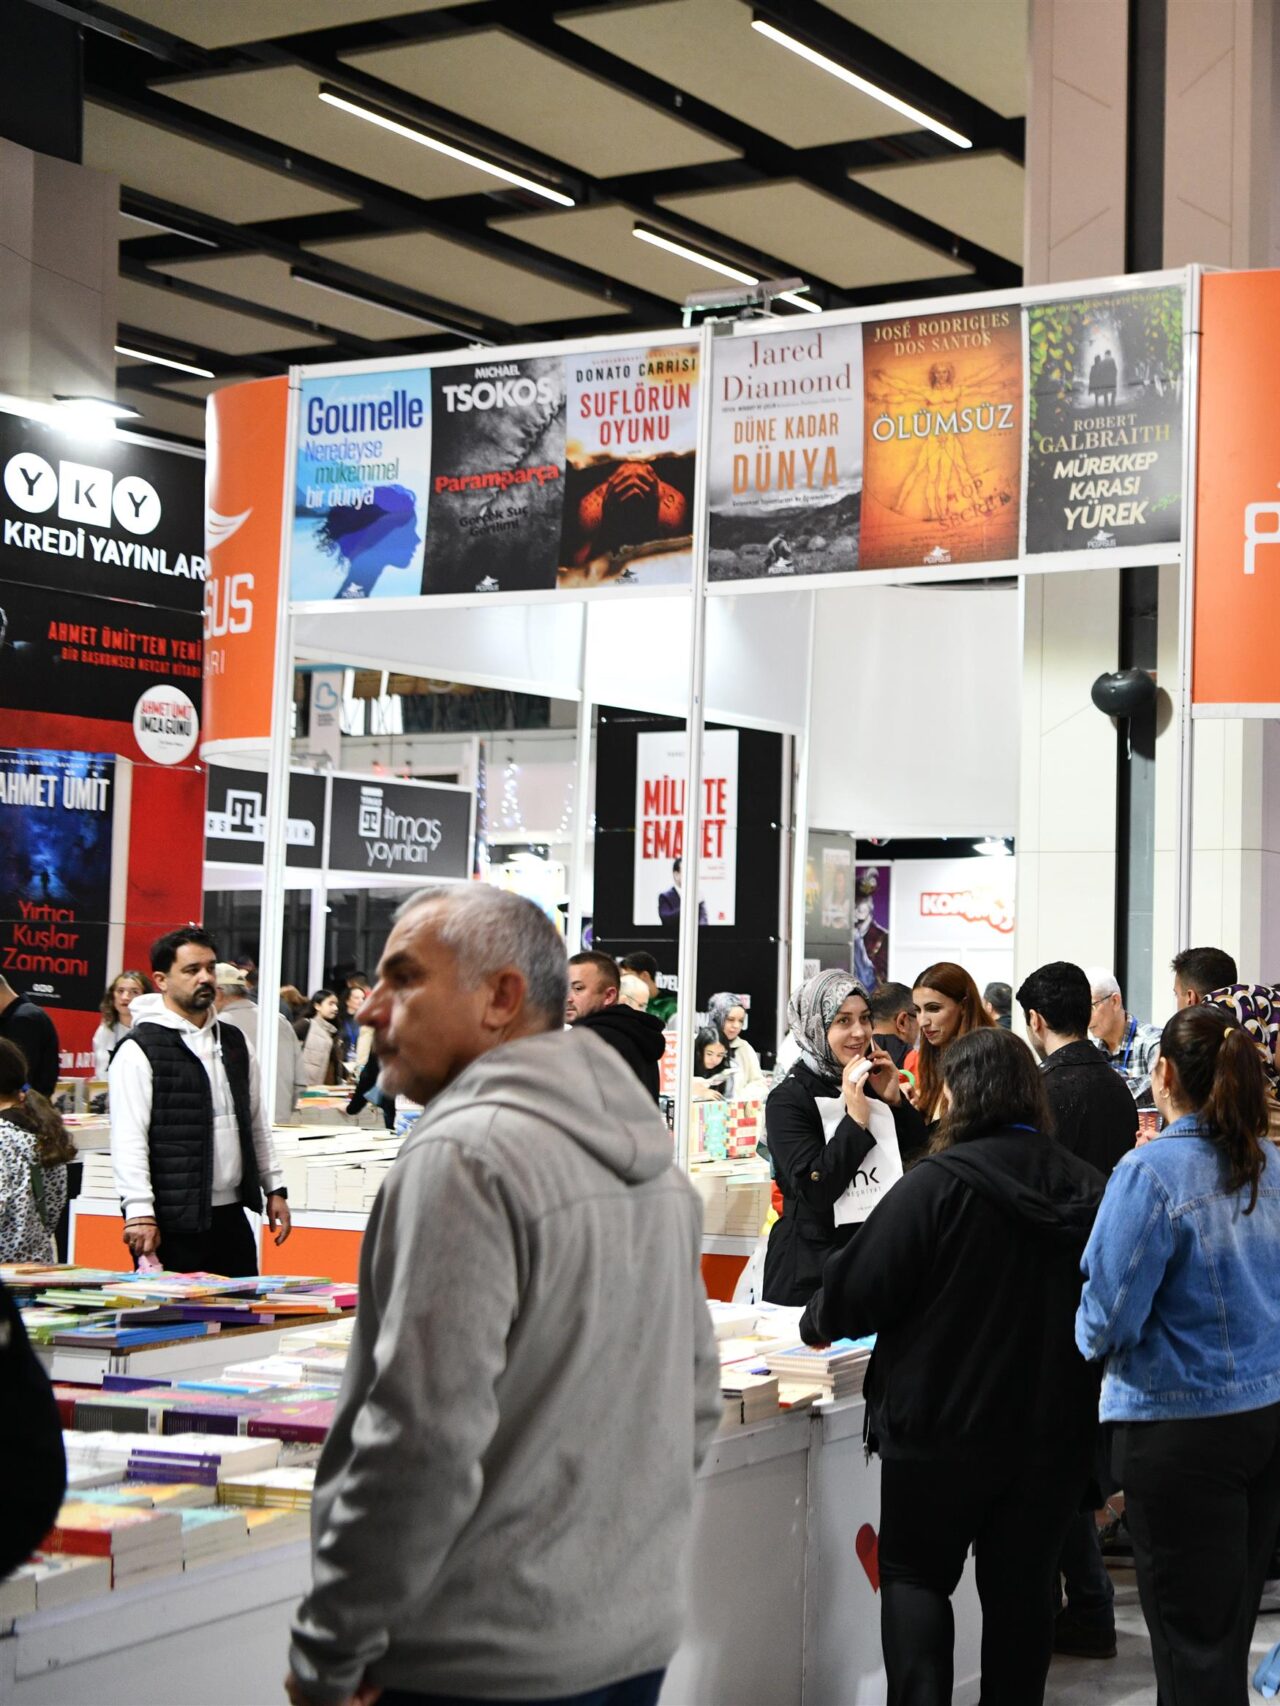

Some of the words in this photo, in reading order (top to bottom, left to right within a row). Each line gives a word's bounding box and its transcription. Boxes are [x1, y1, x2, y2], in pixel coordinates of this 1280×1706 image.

[874, 320, 911, 342] JOSÉ
[918, 311, 1010, 335] RODRIGUES
[749, 332, 823, 369] Jared
[894, 339, 925, 356] DOS
[931, 330, 992, 351] SANTOS
[474, 364, 520, 380] MICHAEL
[576, 364, 631, 383] DONATO
[722, 363, 851, 402] Diamond
[442, 377, 556, 413] TSOKOS
[580, 378, 691, 419] SUFLÖRÜN
[307, 388, 424, 436] Gounelle
[872, 402, 1014, 442] ÖLÜMSÜZ
[1073, 412, 1138, 433] ROBERT
[600, 415, 671, 446] OYUNU
[734, 416, 777, 444] DÜNE
[785, 412, 839, 440] KADAR
[1038, 424, 1171, 455] GALBRAITH
[305, 438, 383, 464] Neredeyse
[1053, 451, 1159, 480] MÜREKKEP
[315, 457, 400, 484] mükemmel
[434, 464, 560, 495] Paramparça
[732, 445, 840, 495] DÜNYA
[306, 486, 326, 509] bir
[328, 484, 375, 510] dünya
[1069, 475, 1141, 501] KARASI
[1064, 500, 1149, 531] YÜREK
[4, 518, 85, 559] KREDİ
[48, 621, 97, 646] AHMET
[102, 625, 167, 657] ÜMİT'TEN
[171, 638, 204, 662] YENİ
[0, 772, 58, 808] AHMET
[62, 769, 110, 812] ÜMİT
[643, 775, 727, 817] MİLTE
[383, 806, 442, 851] timaş
[642, 819, 726, 860] EMAET
[17, 899, 75, 923] Yırtıcı
[13, 924, 80, 952] Kuşlar
[3, 947, 89, 977] Zamanı
